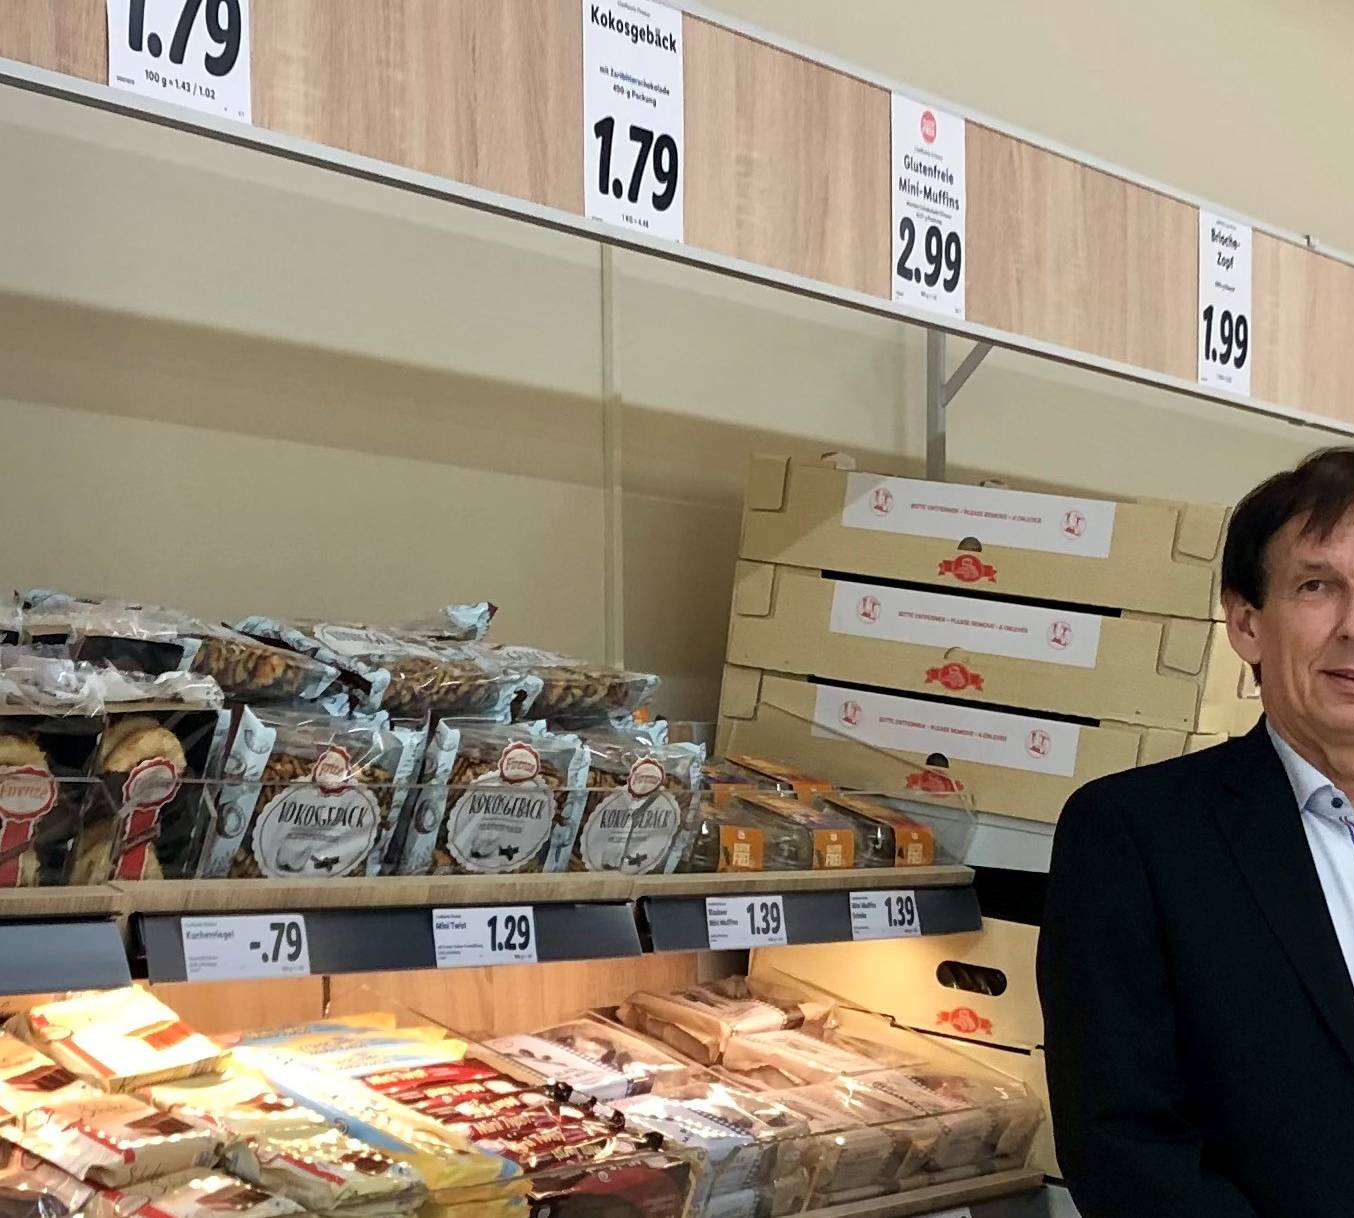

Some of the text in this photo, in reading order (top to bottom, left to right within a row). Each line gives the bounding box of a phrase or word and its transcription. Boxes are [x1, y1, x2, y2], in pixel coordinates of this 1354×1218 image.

[129, 0, 242, 77] 1.79
[591, 4, 677, 53] Kokosgebäck
[145, 69, 160, 83] 100
[594, 116, 679, 212] 1.79
[904, 154, 954, 186] Glutenfreie
[899, 176, 960, 210] Mini-Muffins
[897, 216, 962, 293] 2.99
[1203, 304, 1248, 370] 1.99
[747, 902, 781, 935] 1.39
[885, 896, 915, 927] 1.39
[250, 921, 302, 963] -.79
[487, 915, 530, 951] 1.29
